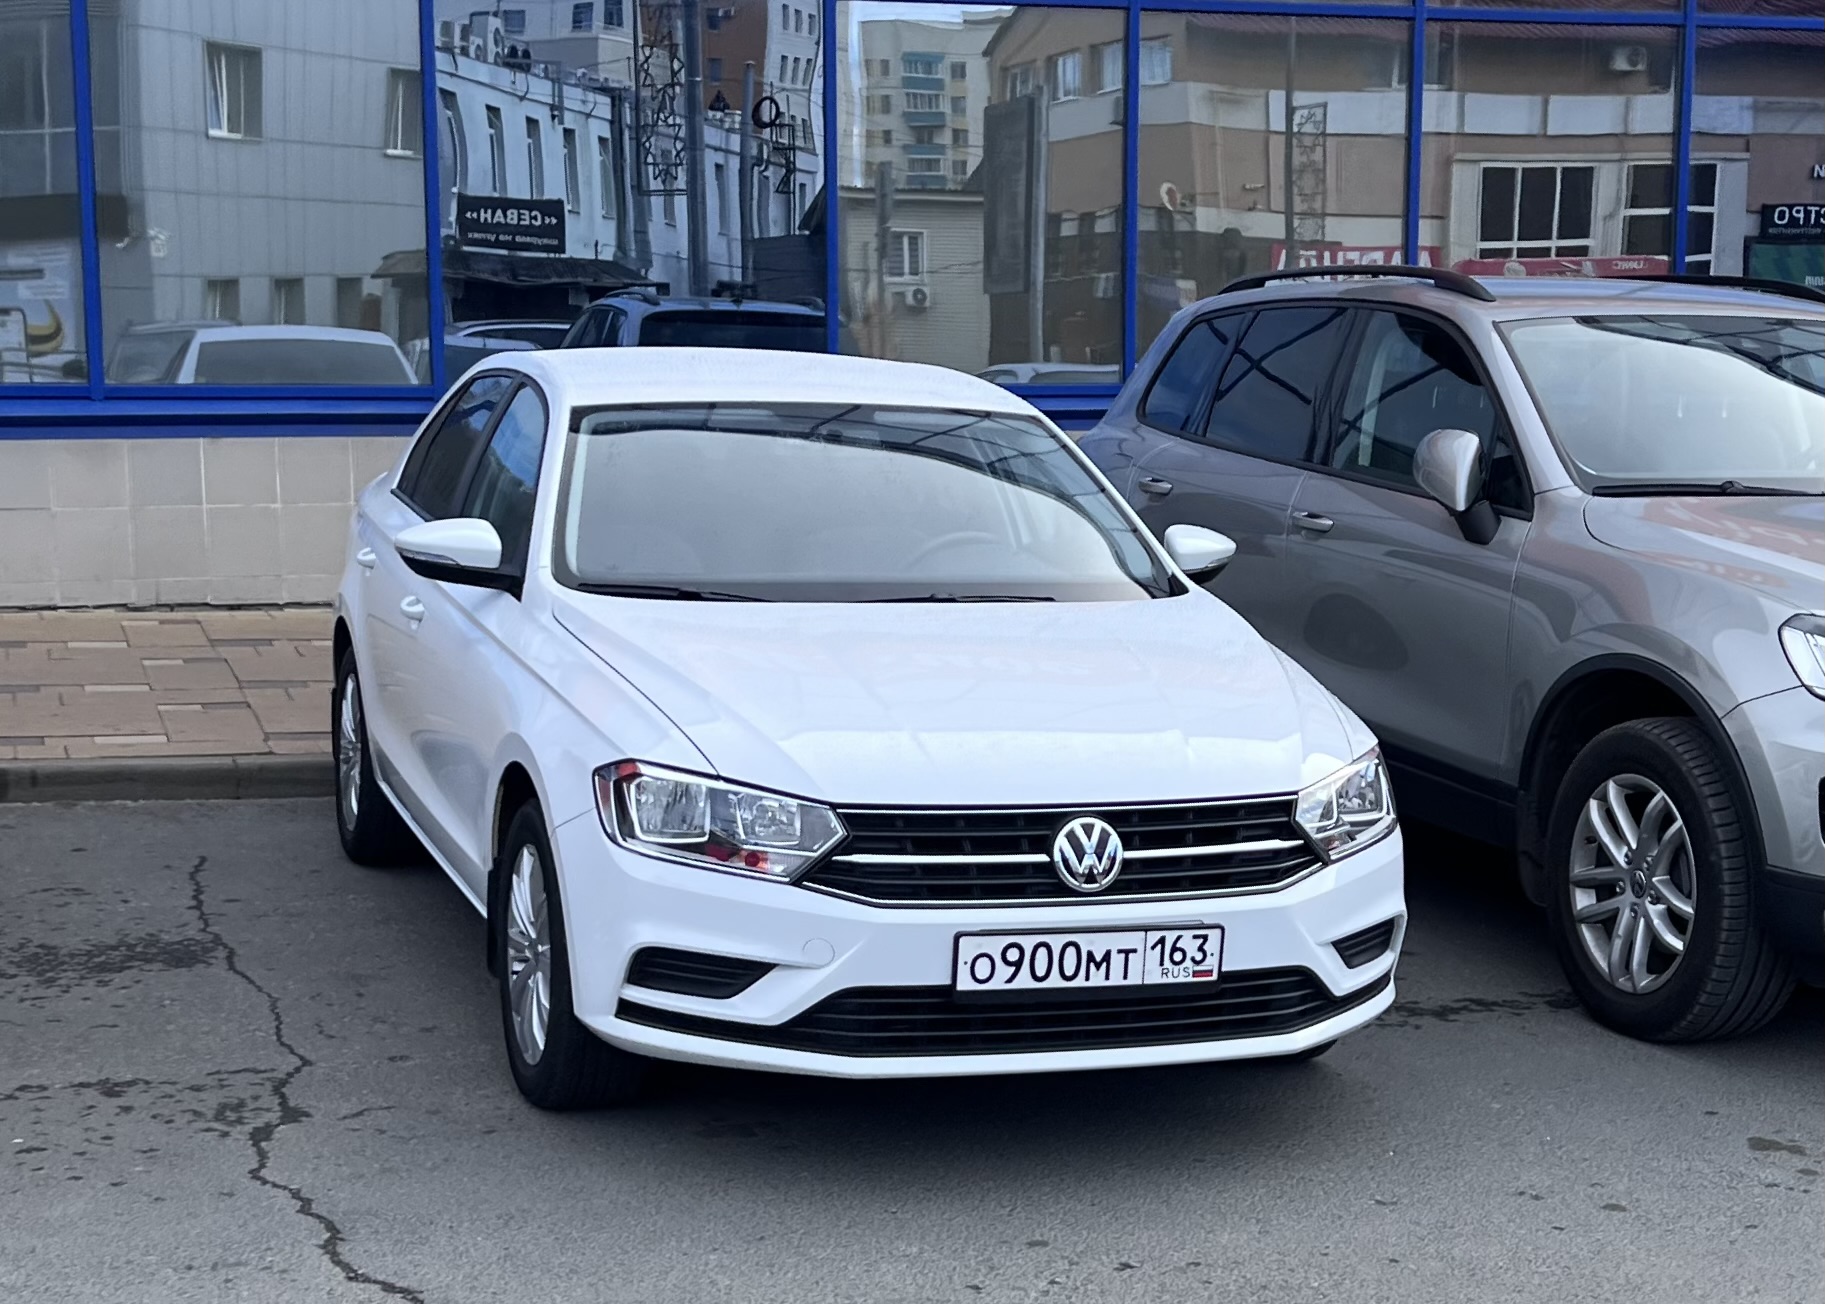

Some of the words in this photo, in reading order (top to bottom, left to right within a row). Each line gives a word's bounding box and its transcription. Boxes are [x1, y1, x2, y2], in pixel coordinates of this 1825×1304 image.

[969, 940, 1138, 985] О900МТ
[1150, 933, 1209, 967] 163
[1161, 967, 1191, 979] RUS
